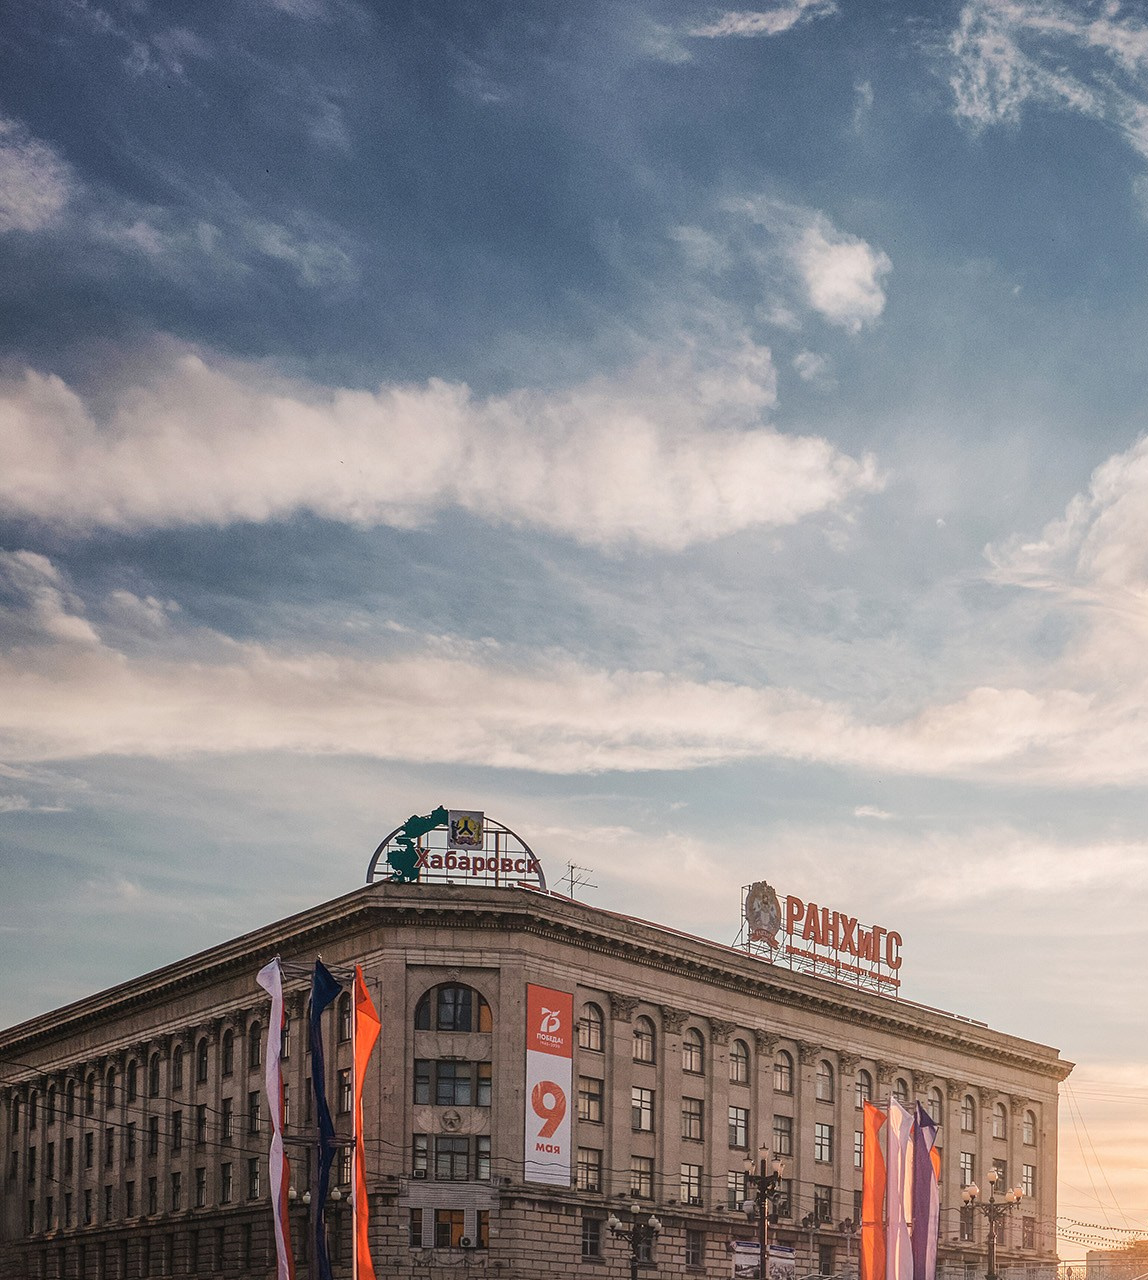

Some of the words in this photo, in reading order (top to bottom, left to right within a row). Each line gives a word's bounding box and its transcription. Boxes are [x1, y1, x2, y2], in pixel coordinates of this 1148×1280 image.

[414, 848, 541, 876] Хабаровск
[786, 894, 903, 970] РАНХиГС
[540, 1007, 561, 1033] 75
[536, 1032, 564, 1044] ПОБЕДА!
[531, 1081, 567, 1138] 9
[535, 1141, 561, 1155] мая
